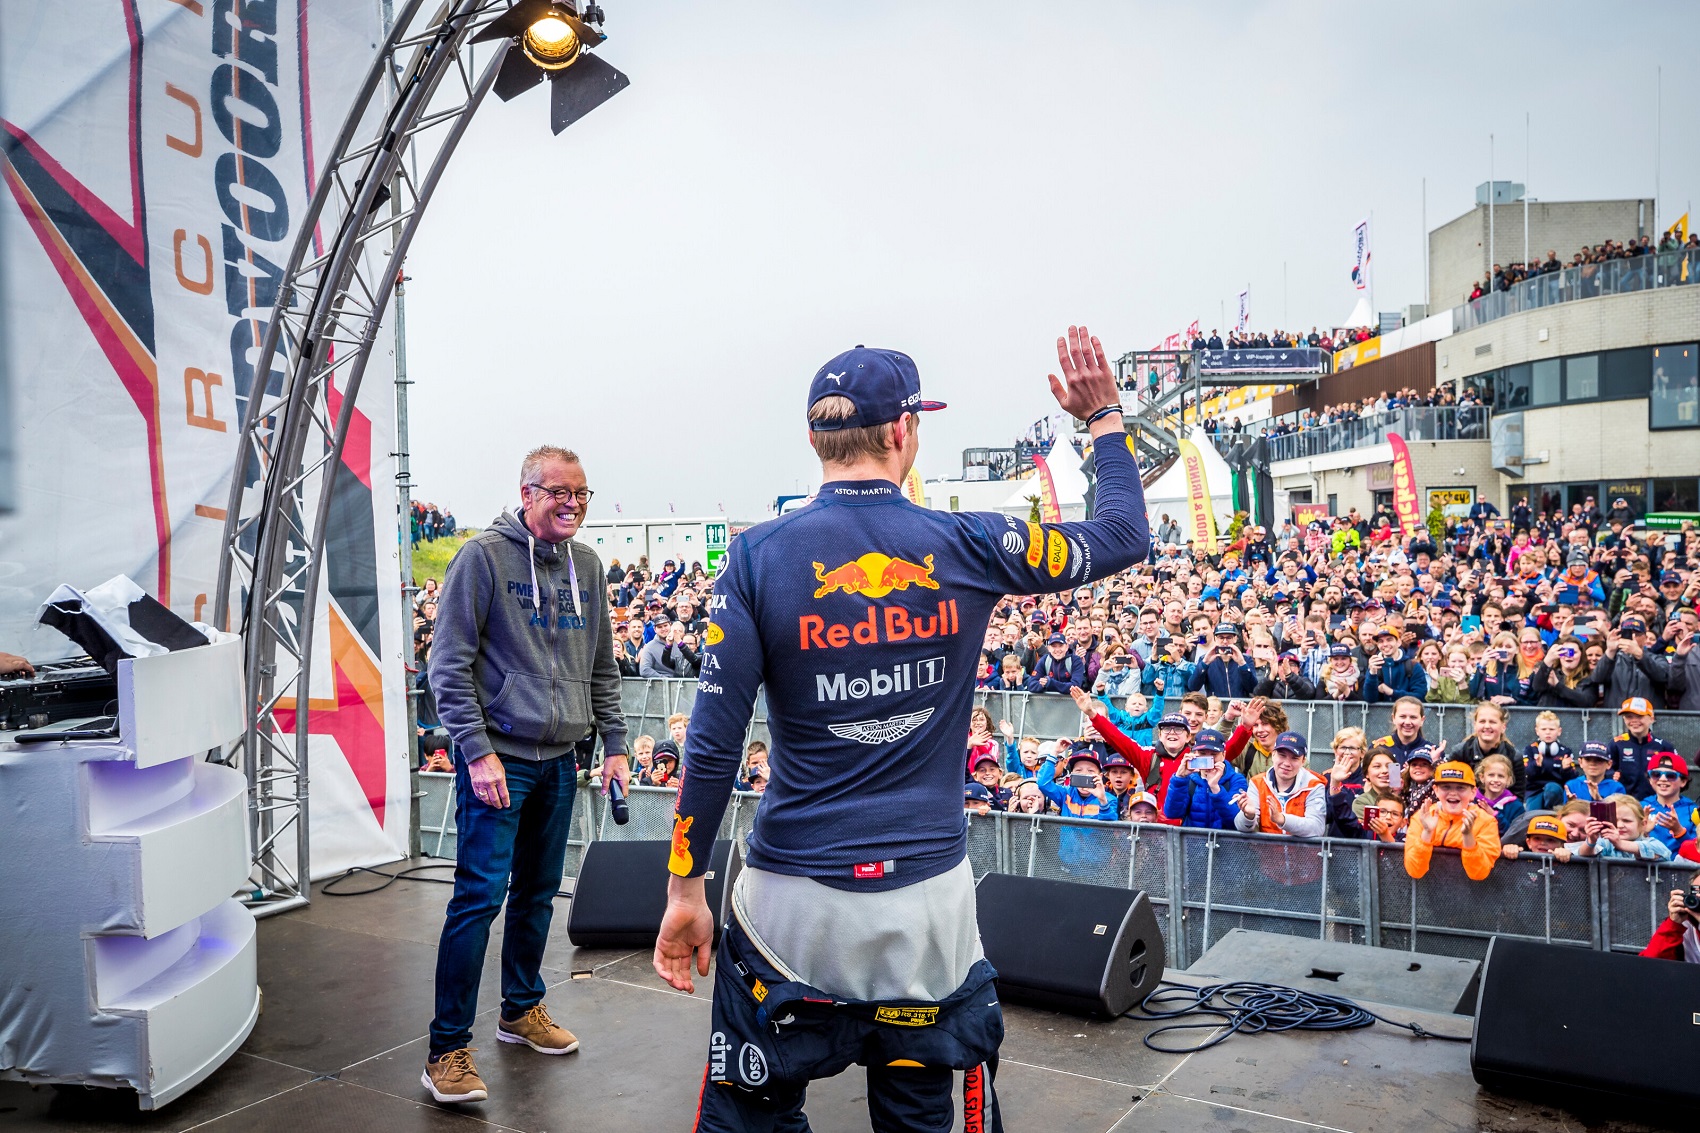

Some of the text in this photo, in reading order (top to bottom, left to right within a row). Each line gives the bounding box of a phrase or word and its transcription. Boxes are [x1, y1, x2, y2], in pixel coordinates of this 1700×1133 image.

[834, 487, 892, 496] ASTON MARTIN
[1076, 533, 1092, 582] ASTON MARTIN
[799, 599, 959, 650] Red Bull
[816, 663, 911, 702] Mobil
[861, 719, 906, 732] ASTON MARTIN
[964, 1096, 978, 1133] GIVES
